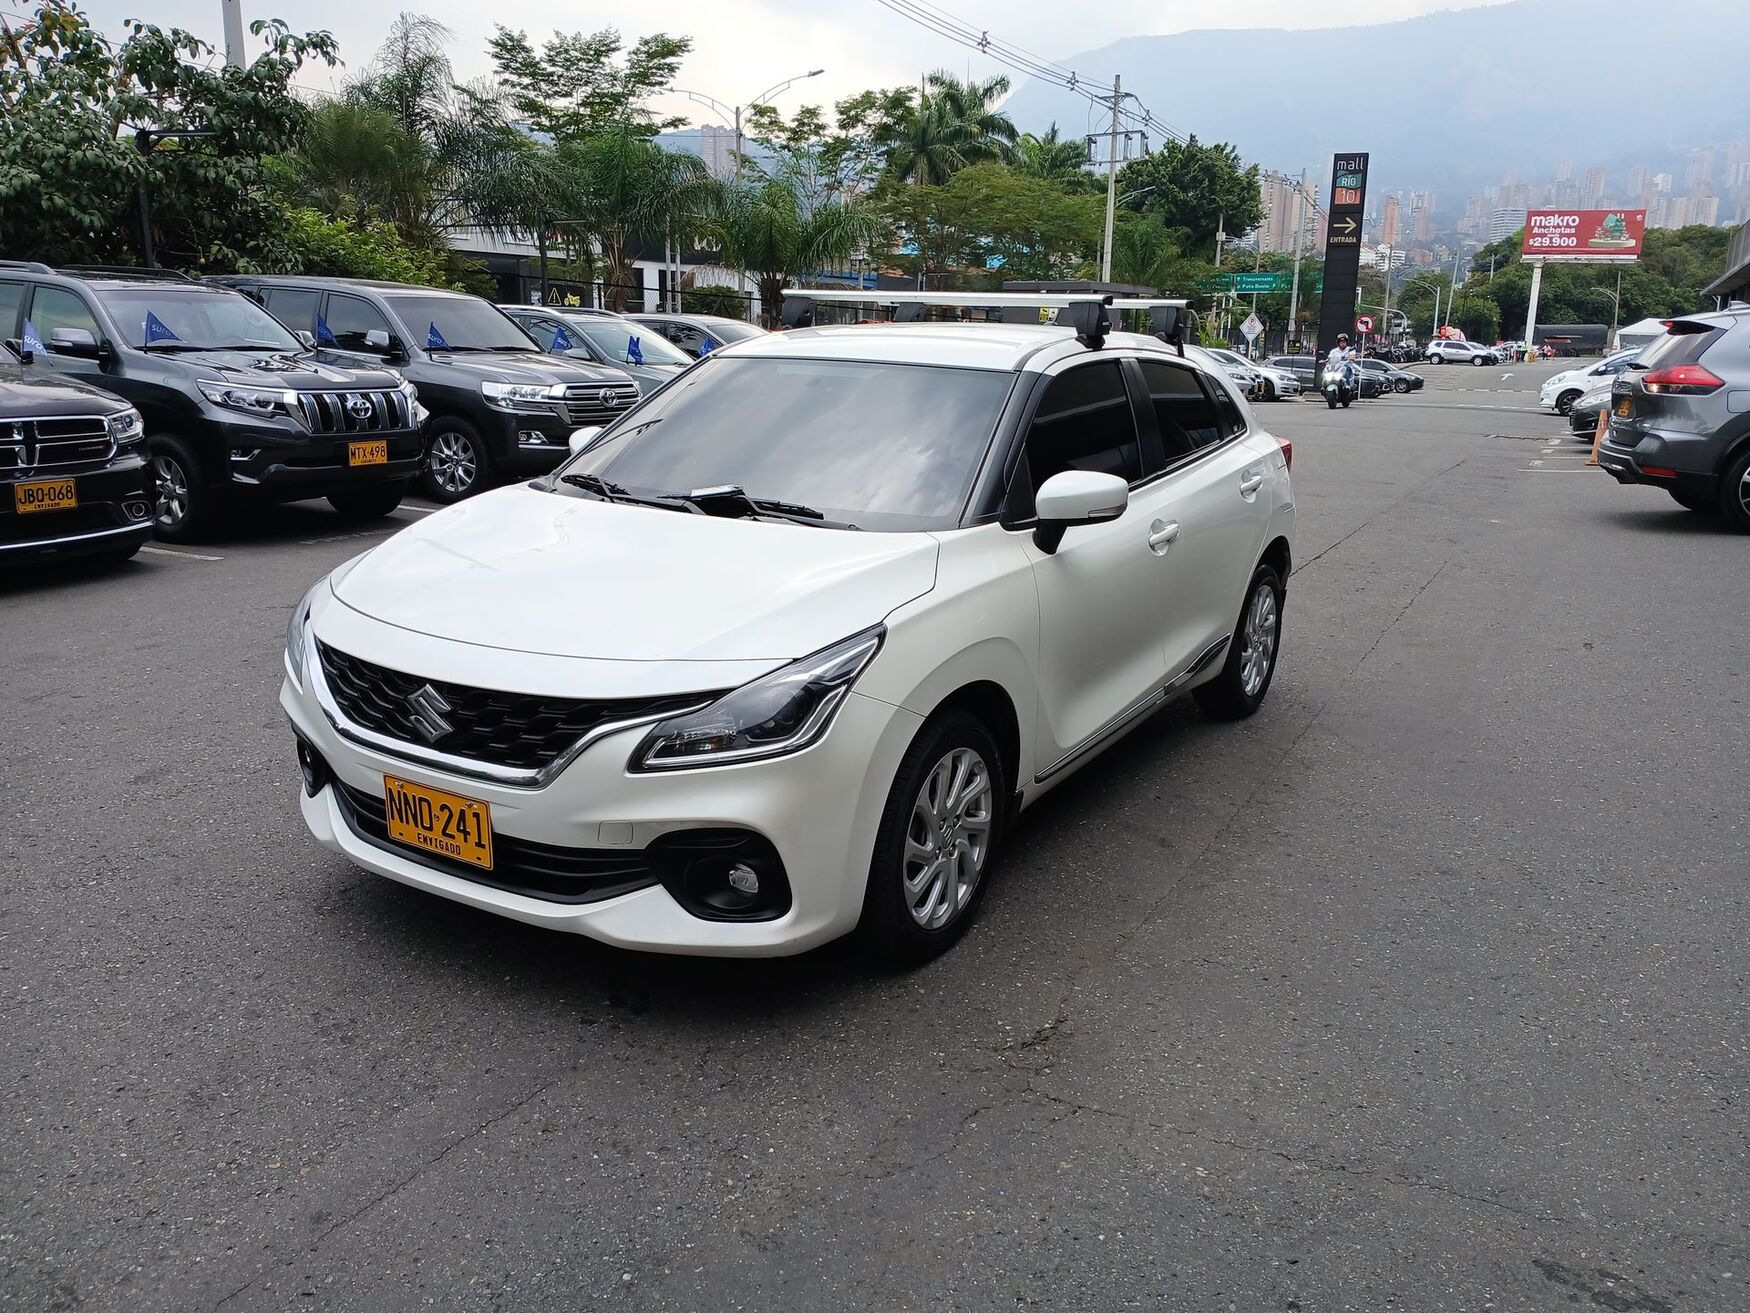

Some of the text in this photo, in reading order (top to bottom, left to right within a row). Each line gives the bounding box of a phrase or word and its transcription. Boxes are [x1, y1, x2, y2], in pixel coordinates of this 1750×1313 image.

[1337, 157, 1363, 170] mall
[1341, 190, 1356, 203] 10
[1530, 214, 1580, 227] makro
[1528, 237, 1577, 247] $29.900
[151, 324, 171, 336] sura
[24, 335, 43, 350] sura
[417, 832, 462, 856] ENVIGADO
